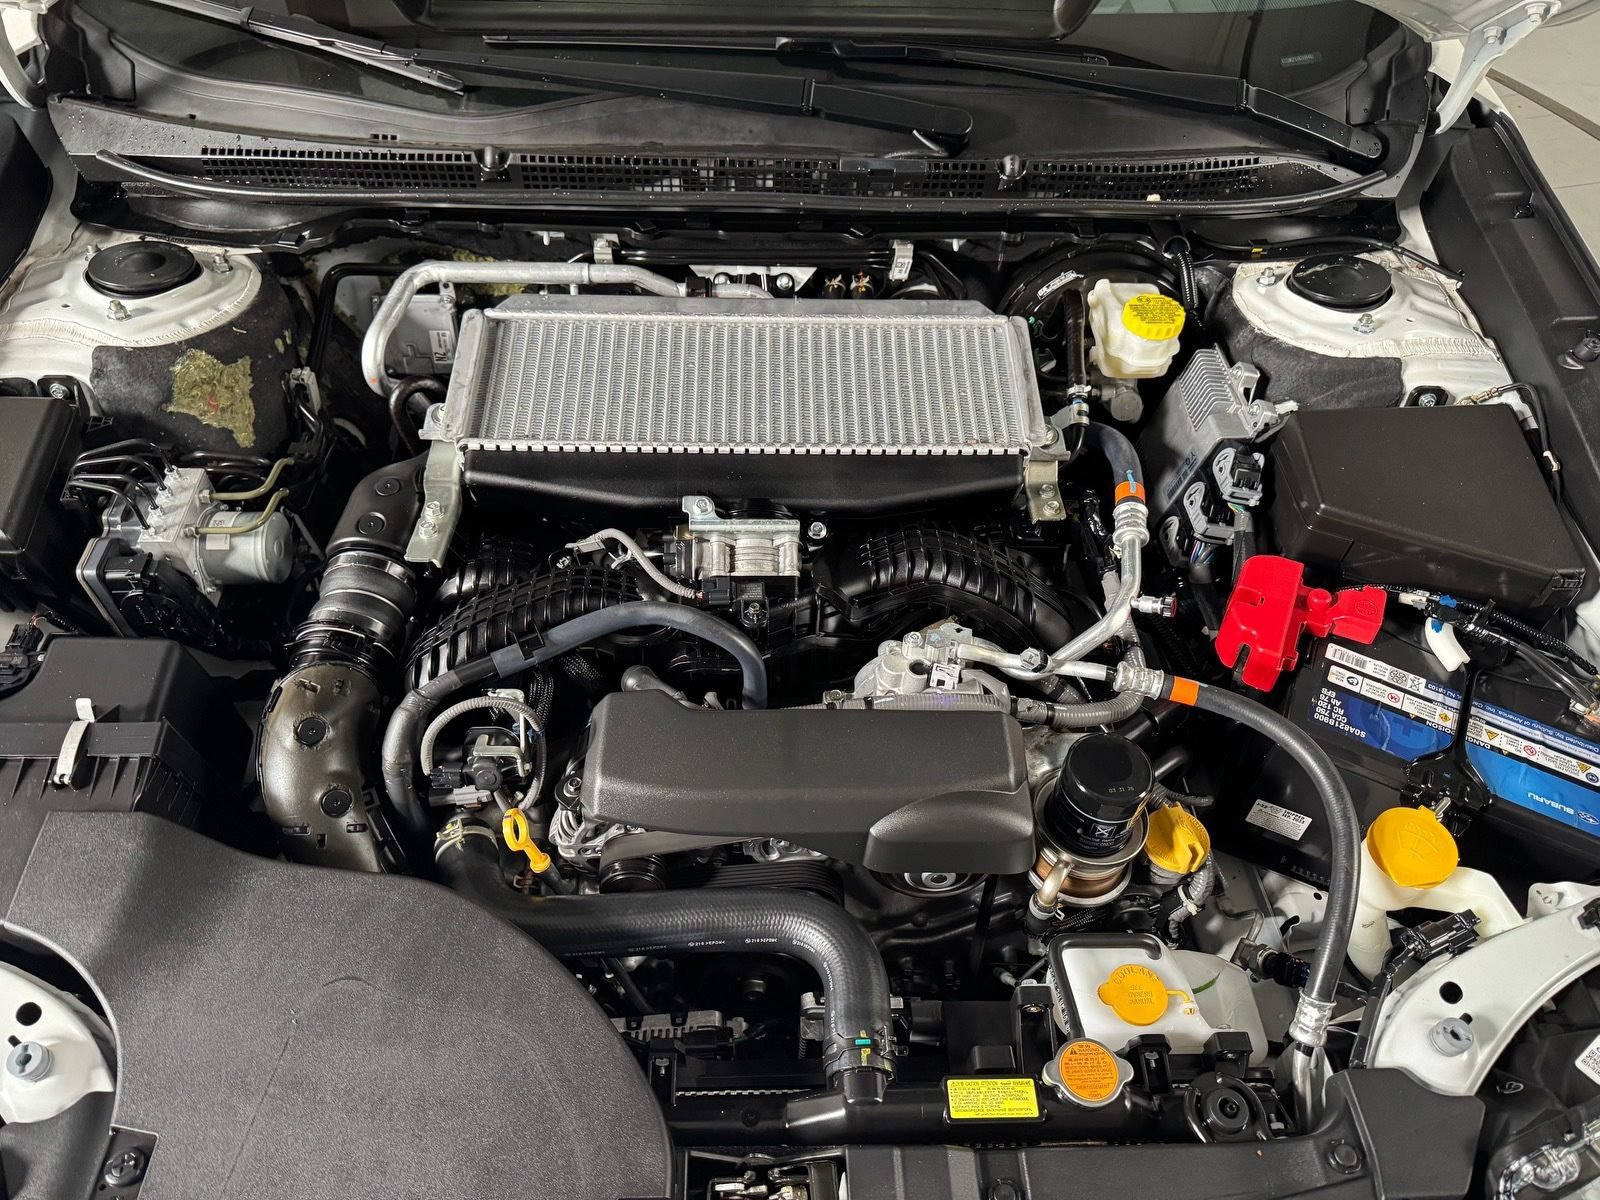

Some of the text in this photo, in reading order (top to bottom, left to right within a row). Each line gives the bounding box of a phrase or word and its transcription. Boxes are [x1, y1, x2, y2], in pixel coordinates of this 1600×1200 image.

[1317, 700, 1344, 715] RC 120
[1331, 712, 1347, 724] CCA
[1527, 792, 1575, 815] SUBARU
